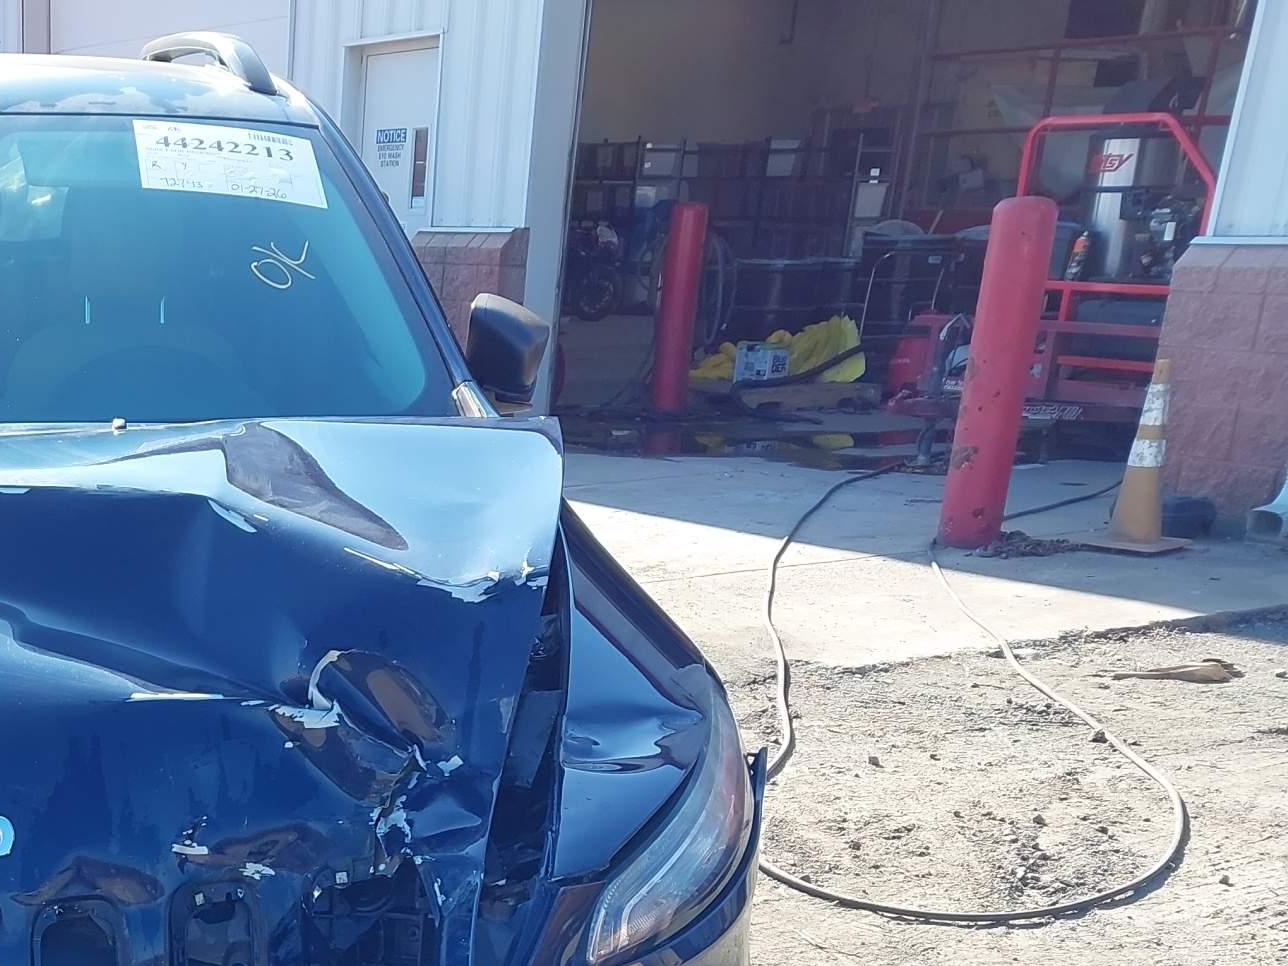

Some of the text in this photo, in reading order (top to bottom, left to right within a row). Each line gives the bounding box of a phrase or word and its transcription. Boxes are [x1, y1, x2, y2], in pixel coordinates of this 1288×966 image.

[155, 135, 294, 162] 44242213
[377, 129, 406, 143] NOTICE
[251, 240, 316, 289] OK
